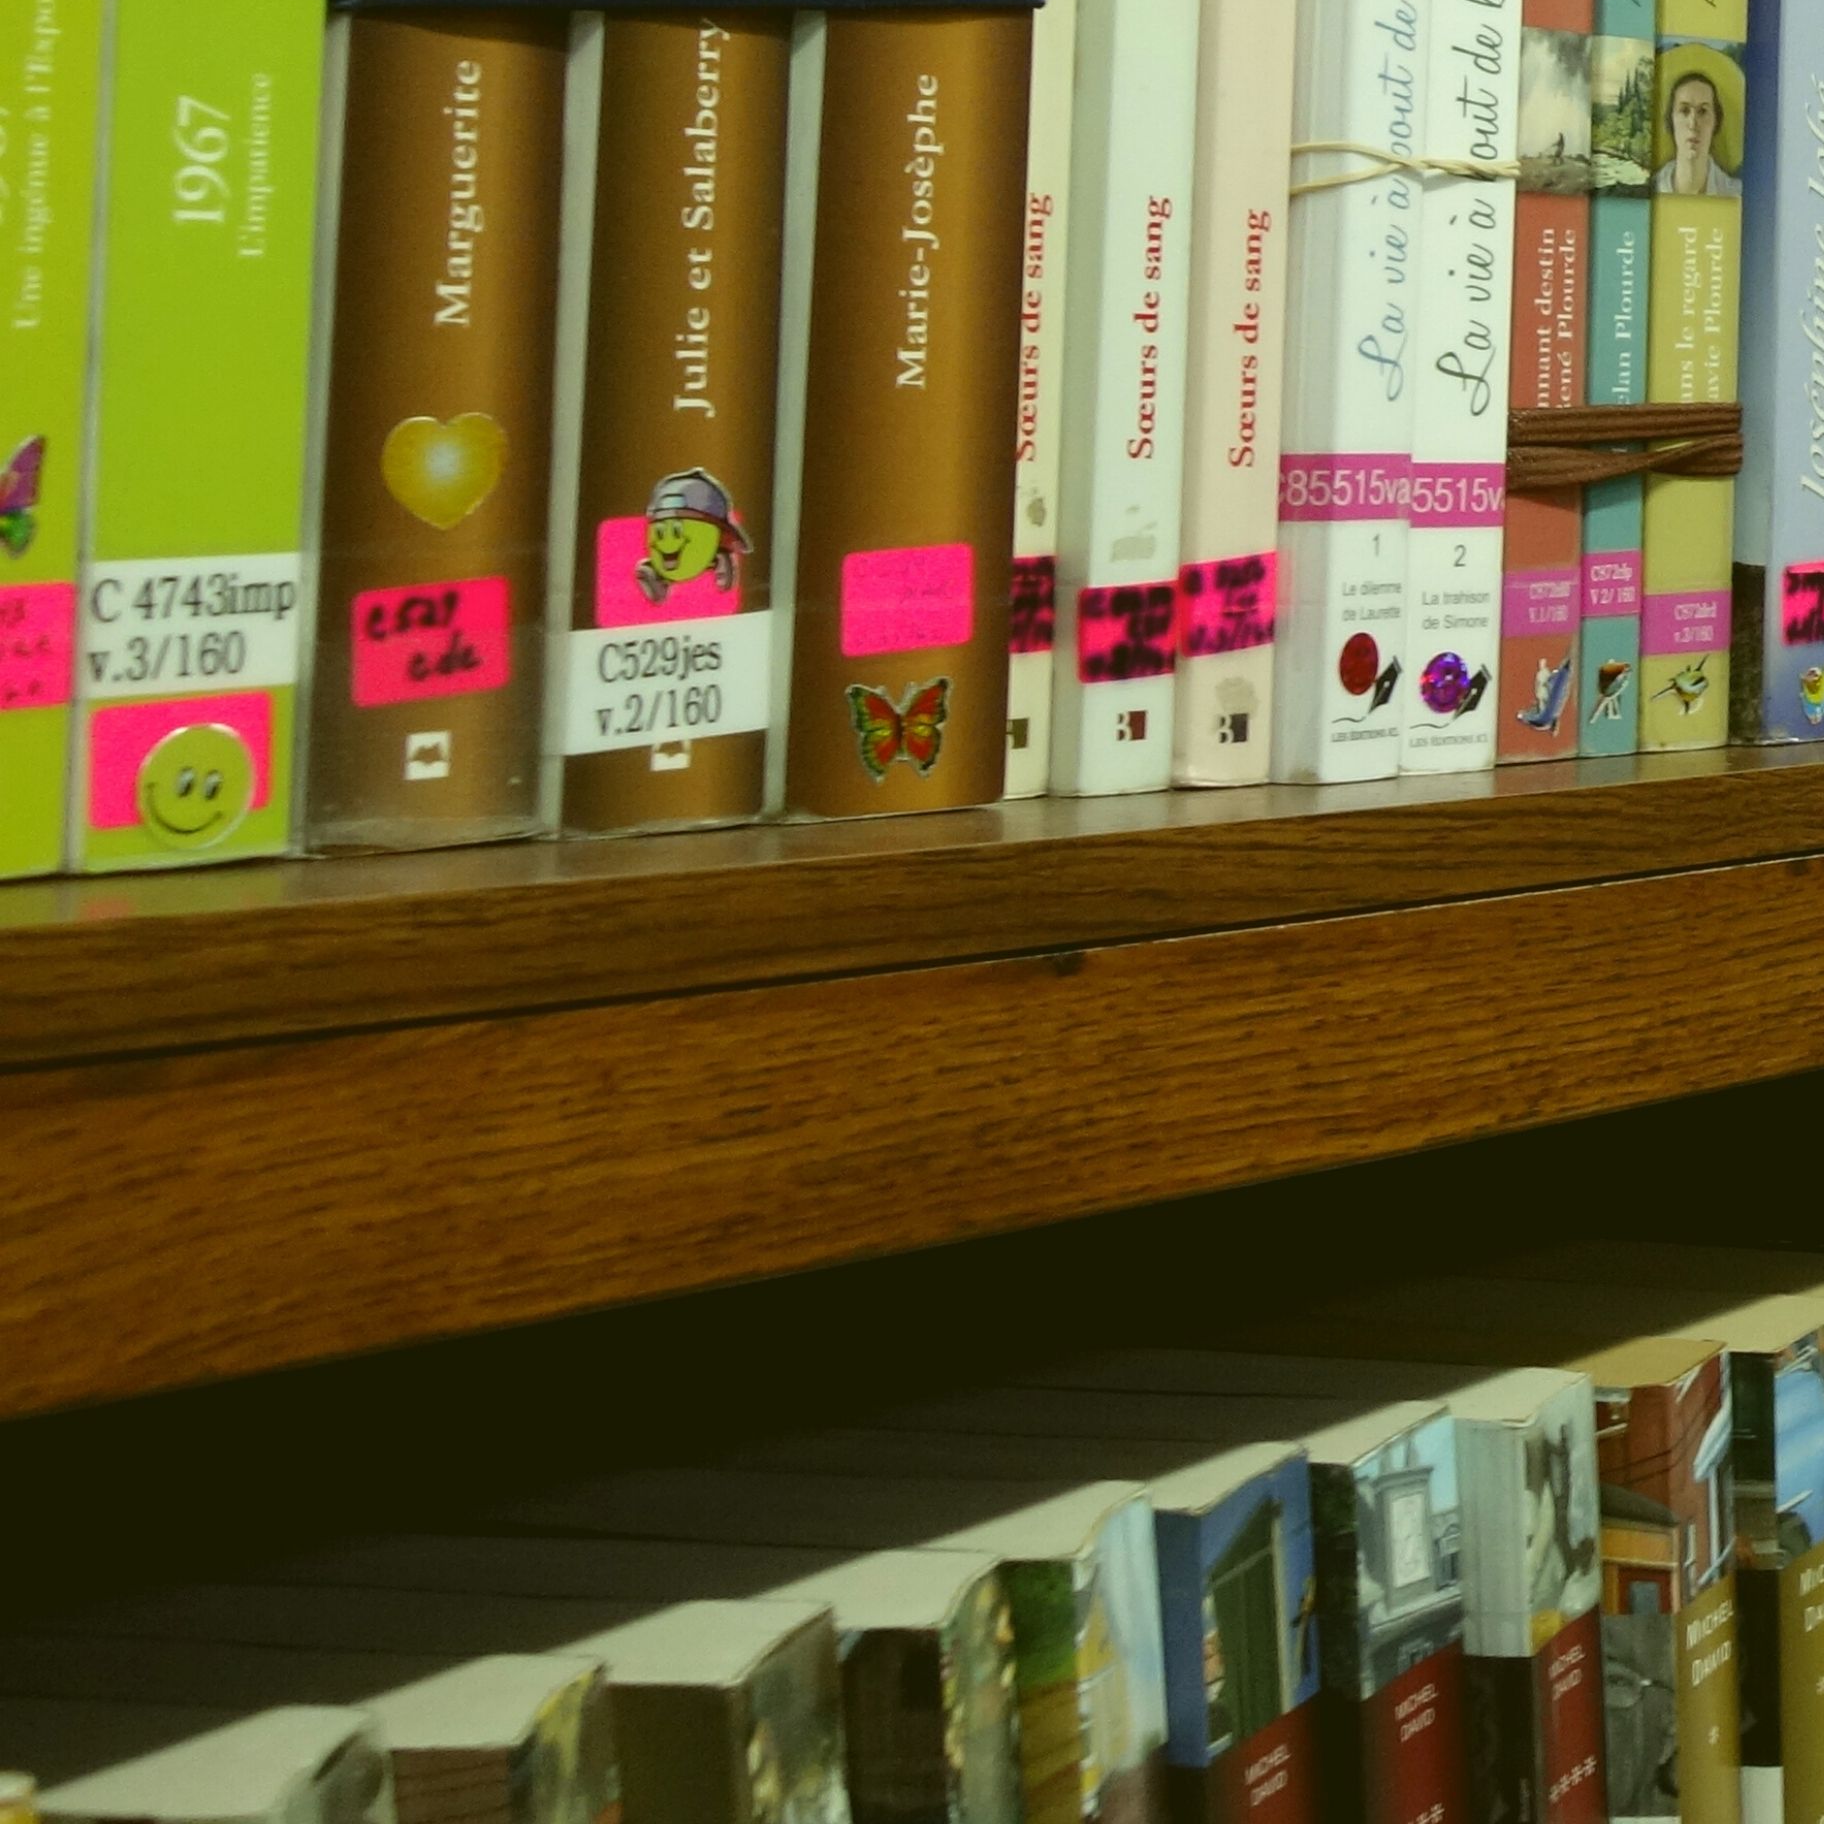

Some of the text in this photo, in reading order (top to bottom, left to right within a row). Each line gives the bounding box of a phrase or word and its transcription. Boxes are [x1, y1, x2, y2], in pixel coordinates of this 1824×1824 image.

[1452, 23, 1505, 79] de
[171, 94, 232, 225] 1967
[434, 60, 484, 328] Marguerite
[673, 18, 730, 419] Julie et Salaberry
[1449, 198, 1495, 229] à
[895, 73, 944, 391] Marie-Josèphe
[1025, 191, 1054, 280] sang
[1368, 231, 1410, 287] vie
[1448, 243, 1496, 304] vie
[1534, 227, 1556, 320] destin
[1557, 228, 1577, 341] Plourde
[1615, 230, 1637, 341] Plourde
[1675, 226, 1702, 353] le regard
[1704, 228, 1725, 335] Plourde
[1019, 290, 1042, 334] de
[1127, 195, 1173, 461] Sœurs de sang
[1228, 208, 1273, 469] Sœurs de sang
[1372, 534, 1380, 556] 1
[1454, 544, 1466, 568] 2
[92, 572, 297, 625] C 4743imp
[1422, 590, 1490, 606] La trahison
[1422, 615, 1490, 630] de Simone
[87, 630, 247, 684] v.3/160
[597, 636, 722, 686] C529jes
[593, 683, 724, 737] v.2/160
[1686, 1598, 1735, 1651] MICHEL
[1691, 1640, 1733, 1687] DAVID
